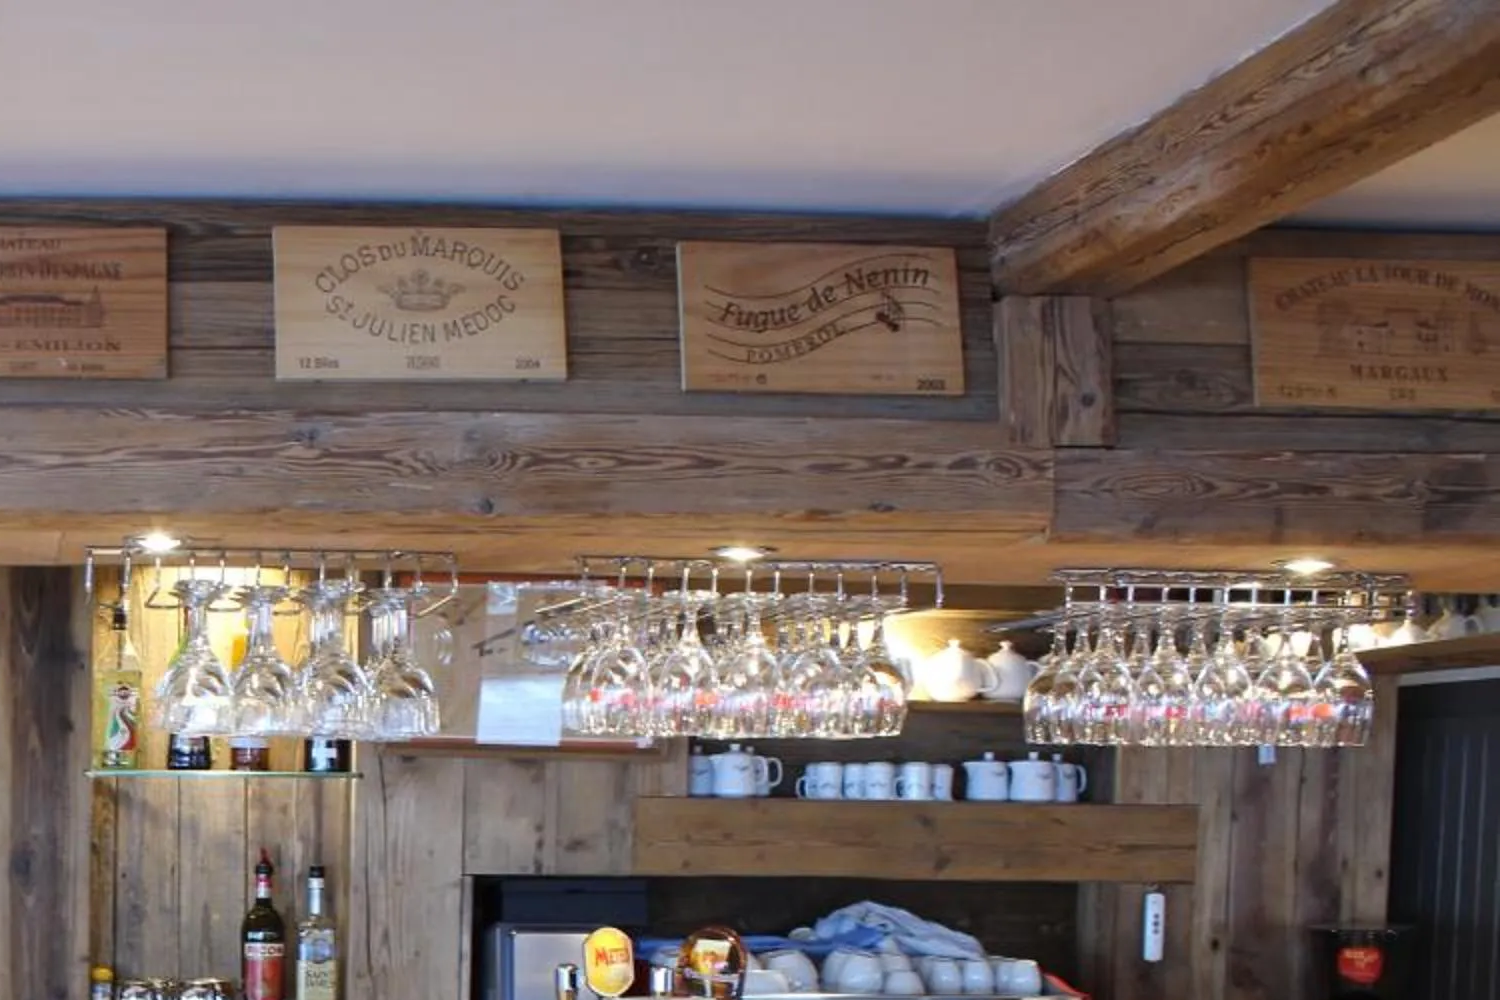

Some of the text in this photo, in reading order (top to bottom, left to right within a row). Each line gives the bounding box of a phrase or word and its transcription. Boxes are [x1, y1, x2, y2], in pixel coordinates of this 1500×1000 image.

[315, 235, 524, 294] CLOS DU MARQUIS
[353, 313, 436, 345] JULIEN
[443, 294, 516, 343] MEDOC
[719, 261, 930, 334] Fugue de Nenin
